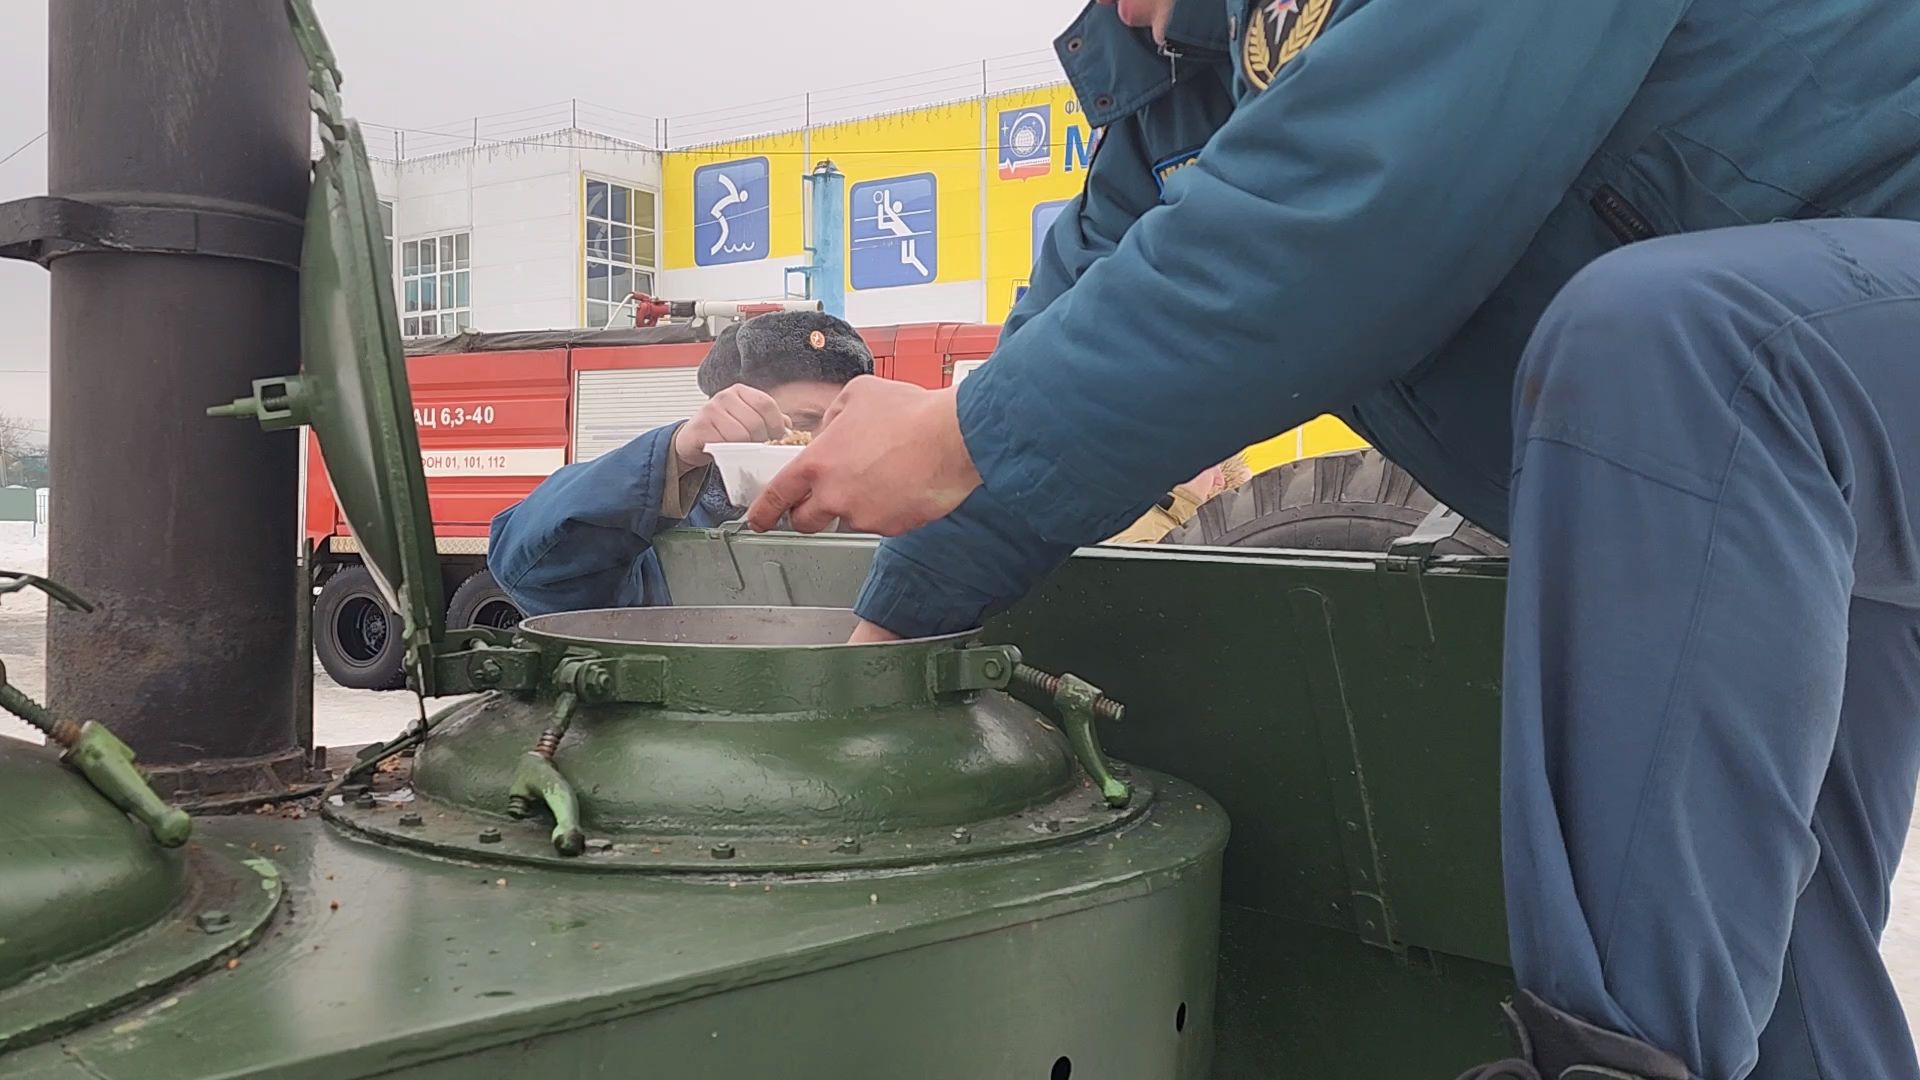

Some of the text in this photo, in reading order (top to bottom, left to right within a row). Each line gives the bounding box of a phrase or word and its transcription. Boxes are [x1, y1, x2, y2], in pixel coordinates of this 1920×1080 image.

[441, 405, 494, 428] 6,3-40
[445, 456, 460, 470] 01,
[464, 456, 484, 470] 101,
[488, 456, 506, 469] 112
